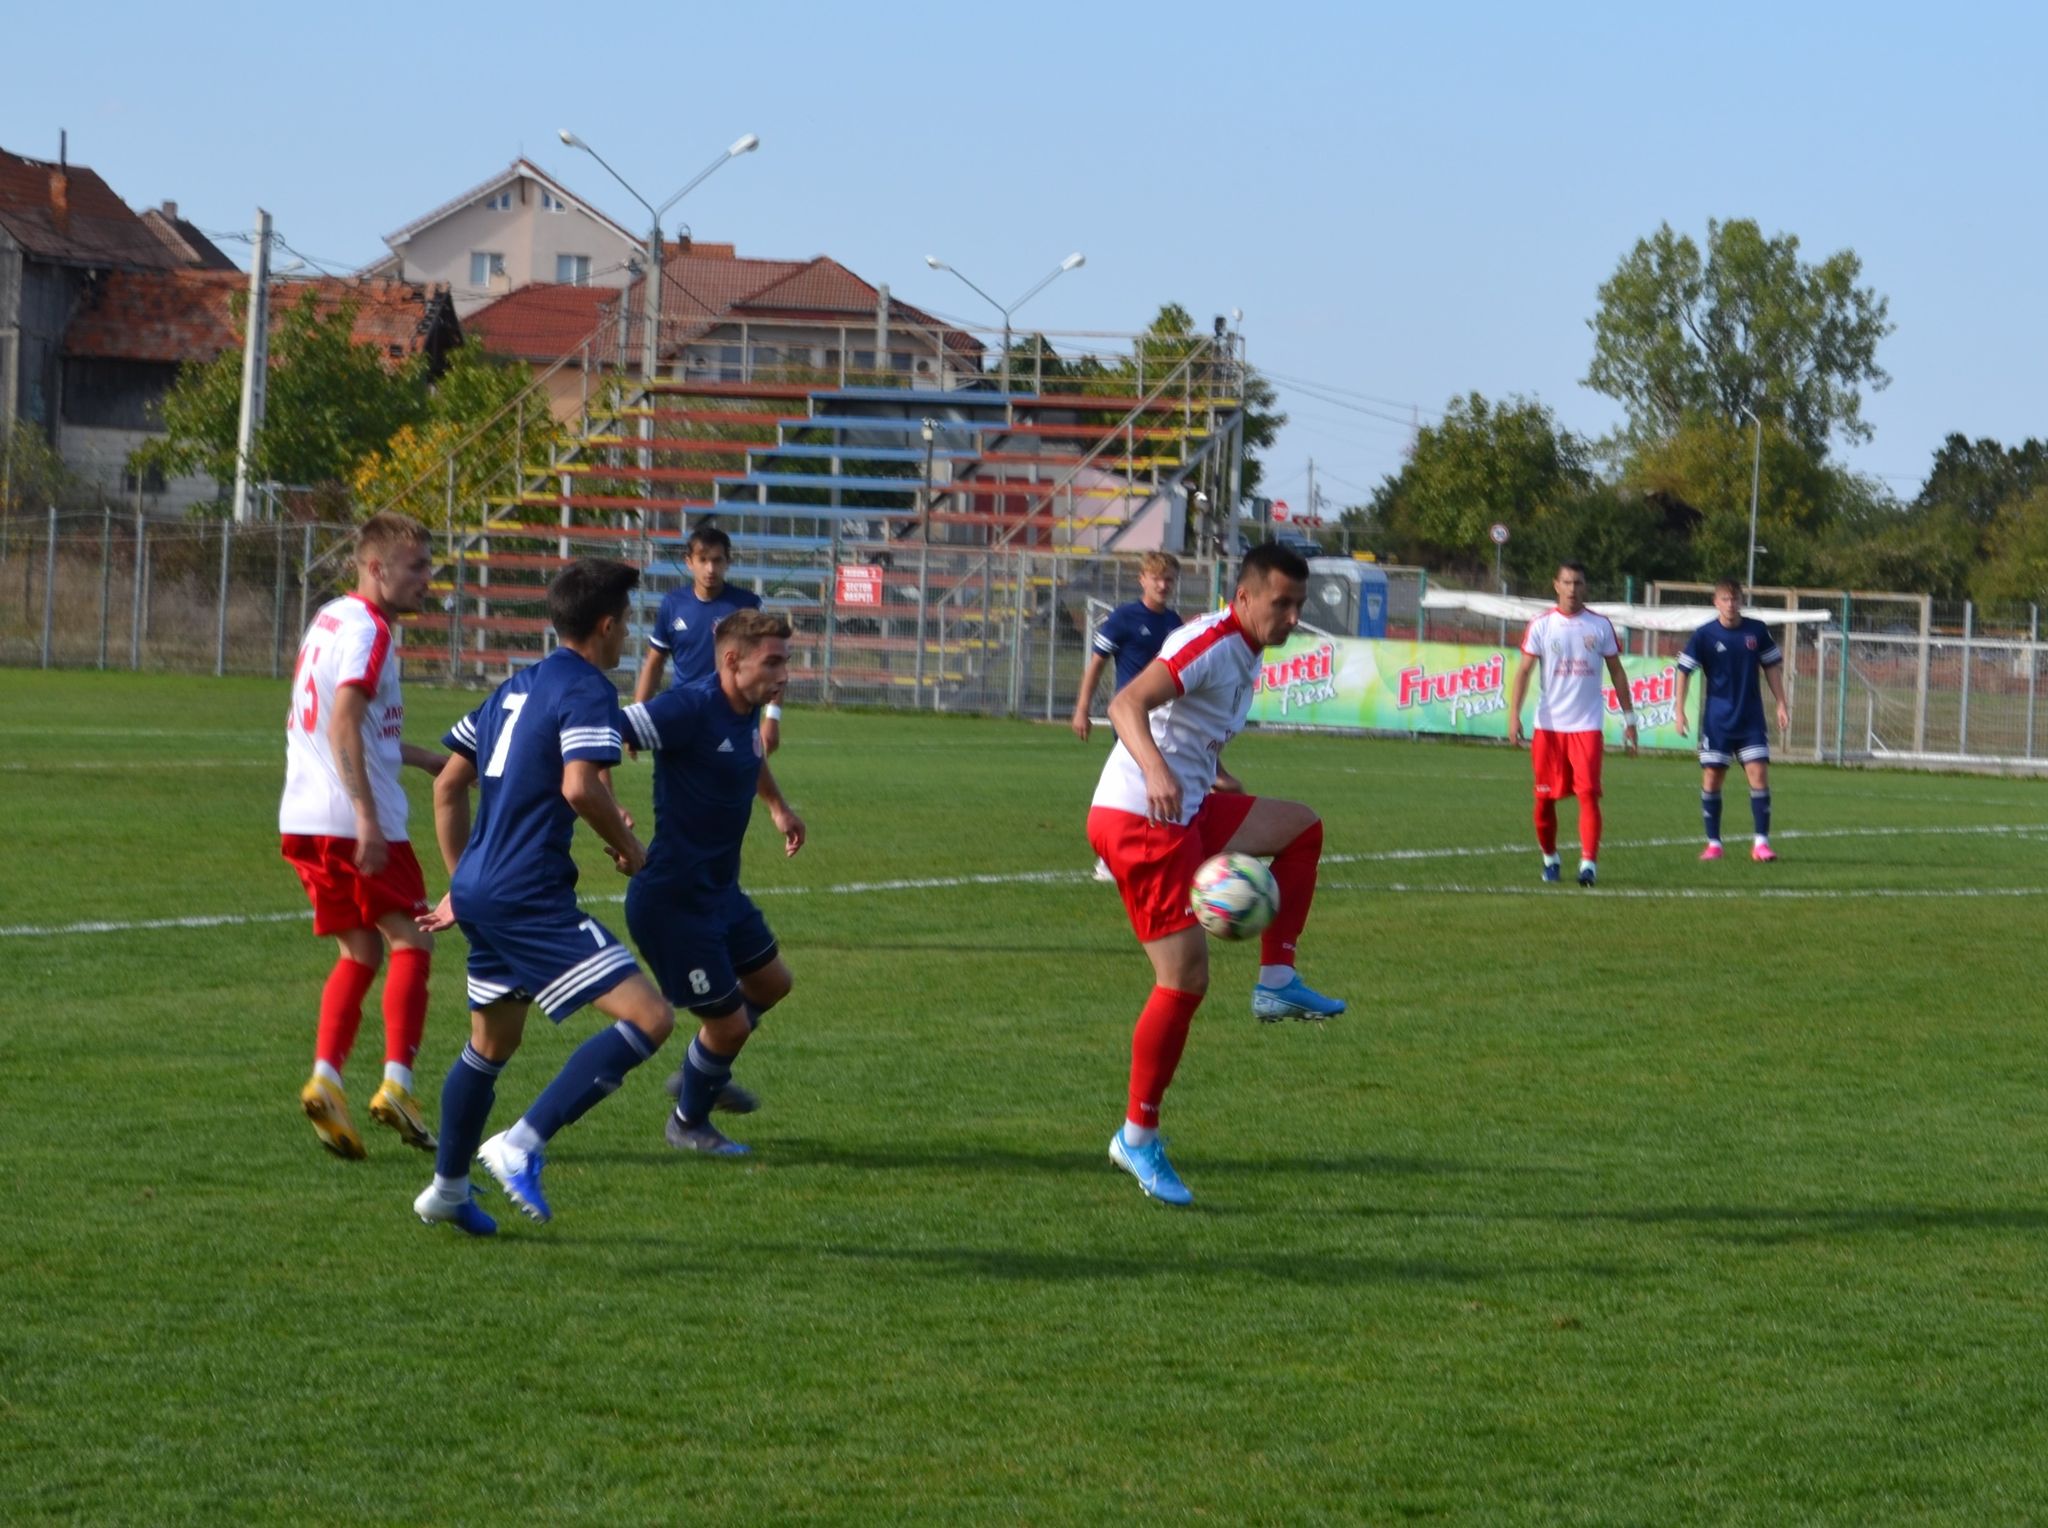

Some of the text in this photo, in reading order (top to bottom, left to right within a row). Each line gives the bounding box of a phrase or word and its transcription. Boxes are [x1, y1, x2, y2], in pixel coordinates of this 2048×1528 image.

[1252, 644, 1332, 692] rutti
[1399, 653, 1504, 709] Frutti
[1451, 686, 1506, 726] fresh
[484, 692, 528, 777] 7
[688, 968, 711, 995] 8
